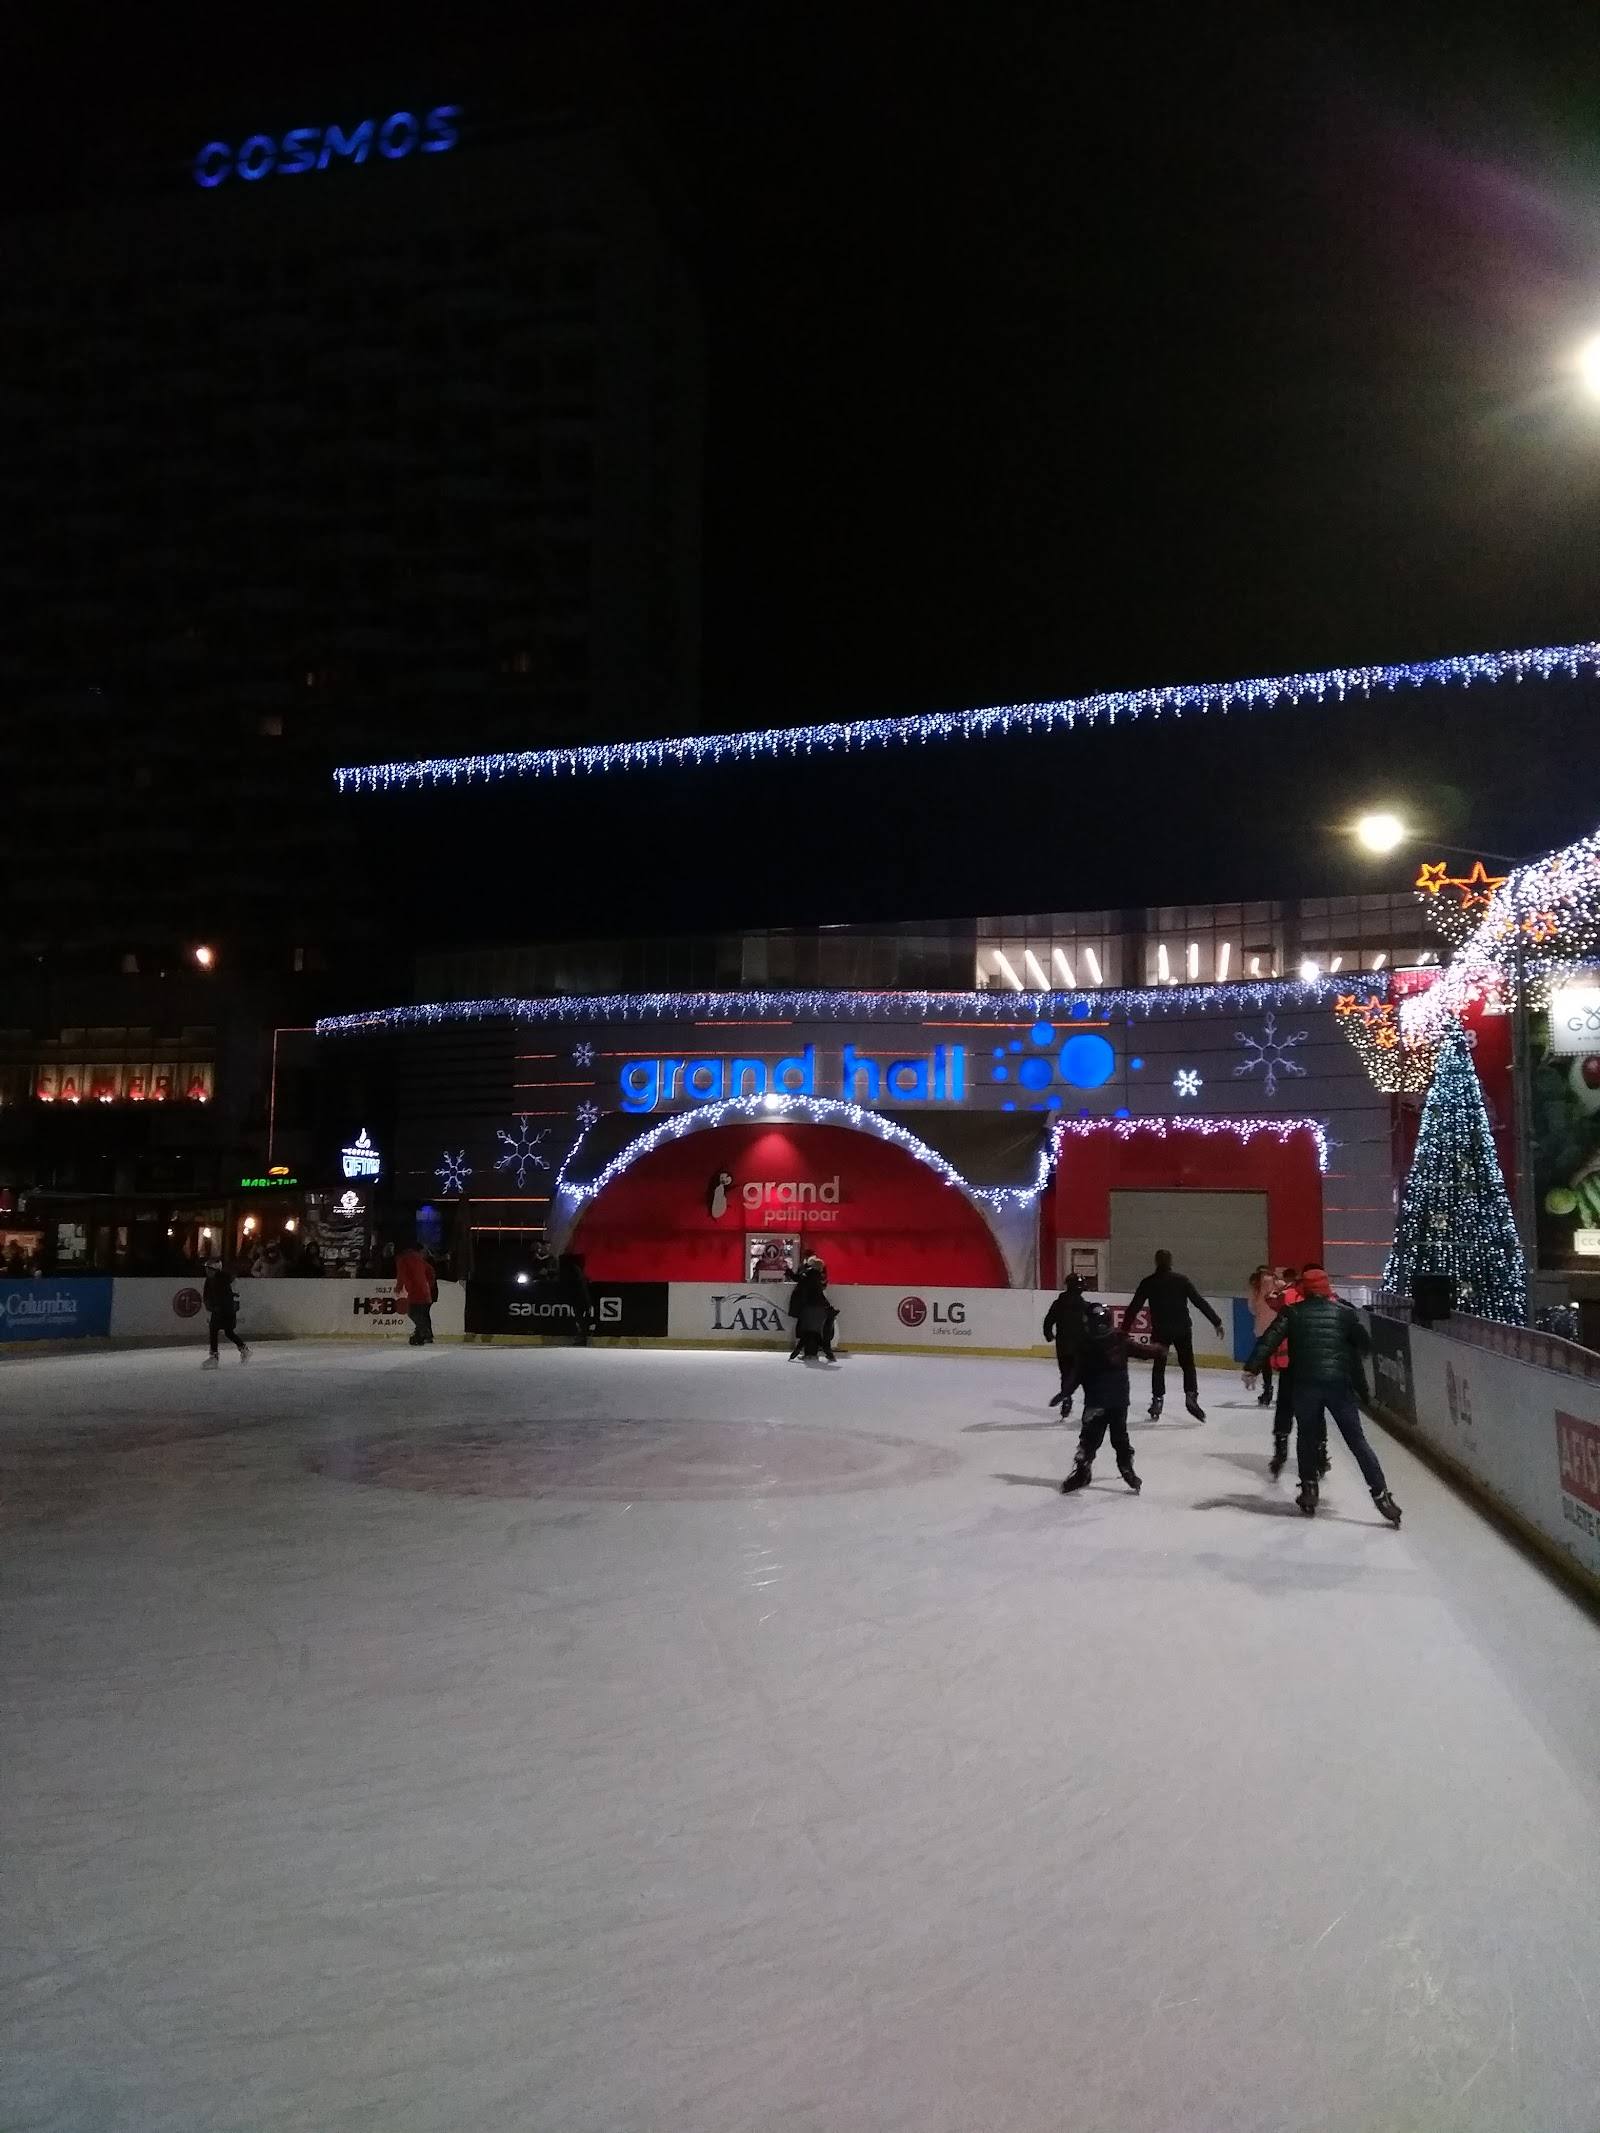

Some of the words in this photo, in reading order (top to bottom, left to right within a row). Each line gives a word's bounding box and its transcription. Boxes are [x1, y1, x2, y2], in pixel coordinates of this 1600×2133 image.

[194, 105, 461, 187] COSMOS
[619, 1044, 815, 1113] grand
[843, 1044, 964, 1102] hall
[743, 1176, 839, 1210] grand
[765, 1206, 839, 1226] patinoar
[7, 1292, 77, 1315] Columbia
[711, 1296, 785, 1331] LARA
[933, 1302, 966, 1323] LG
